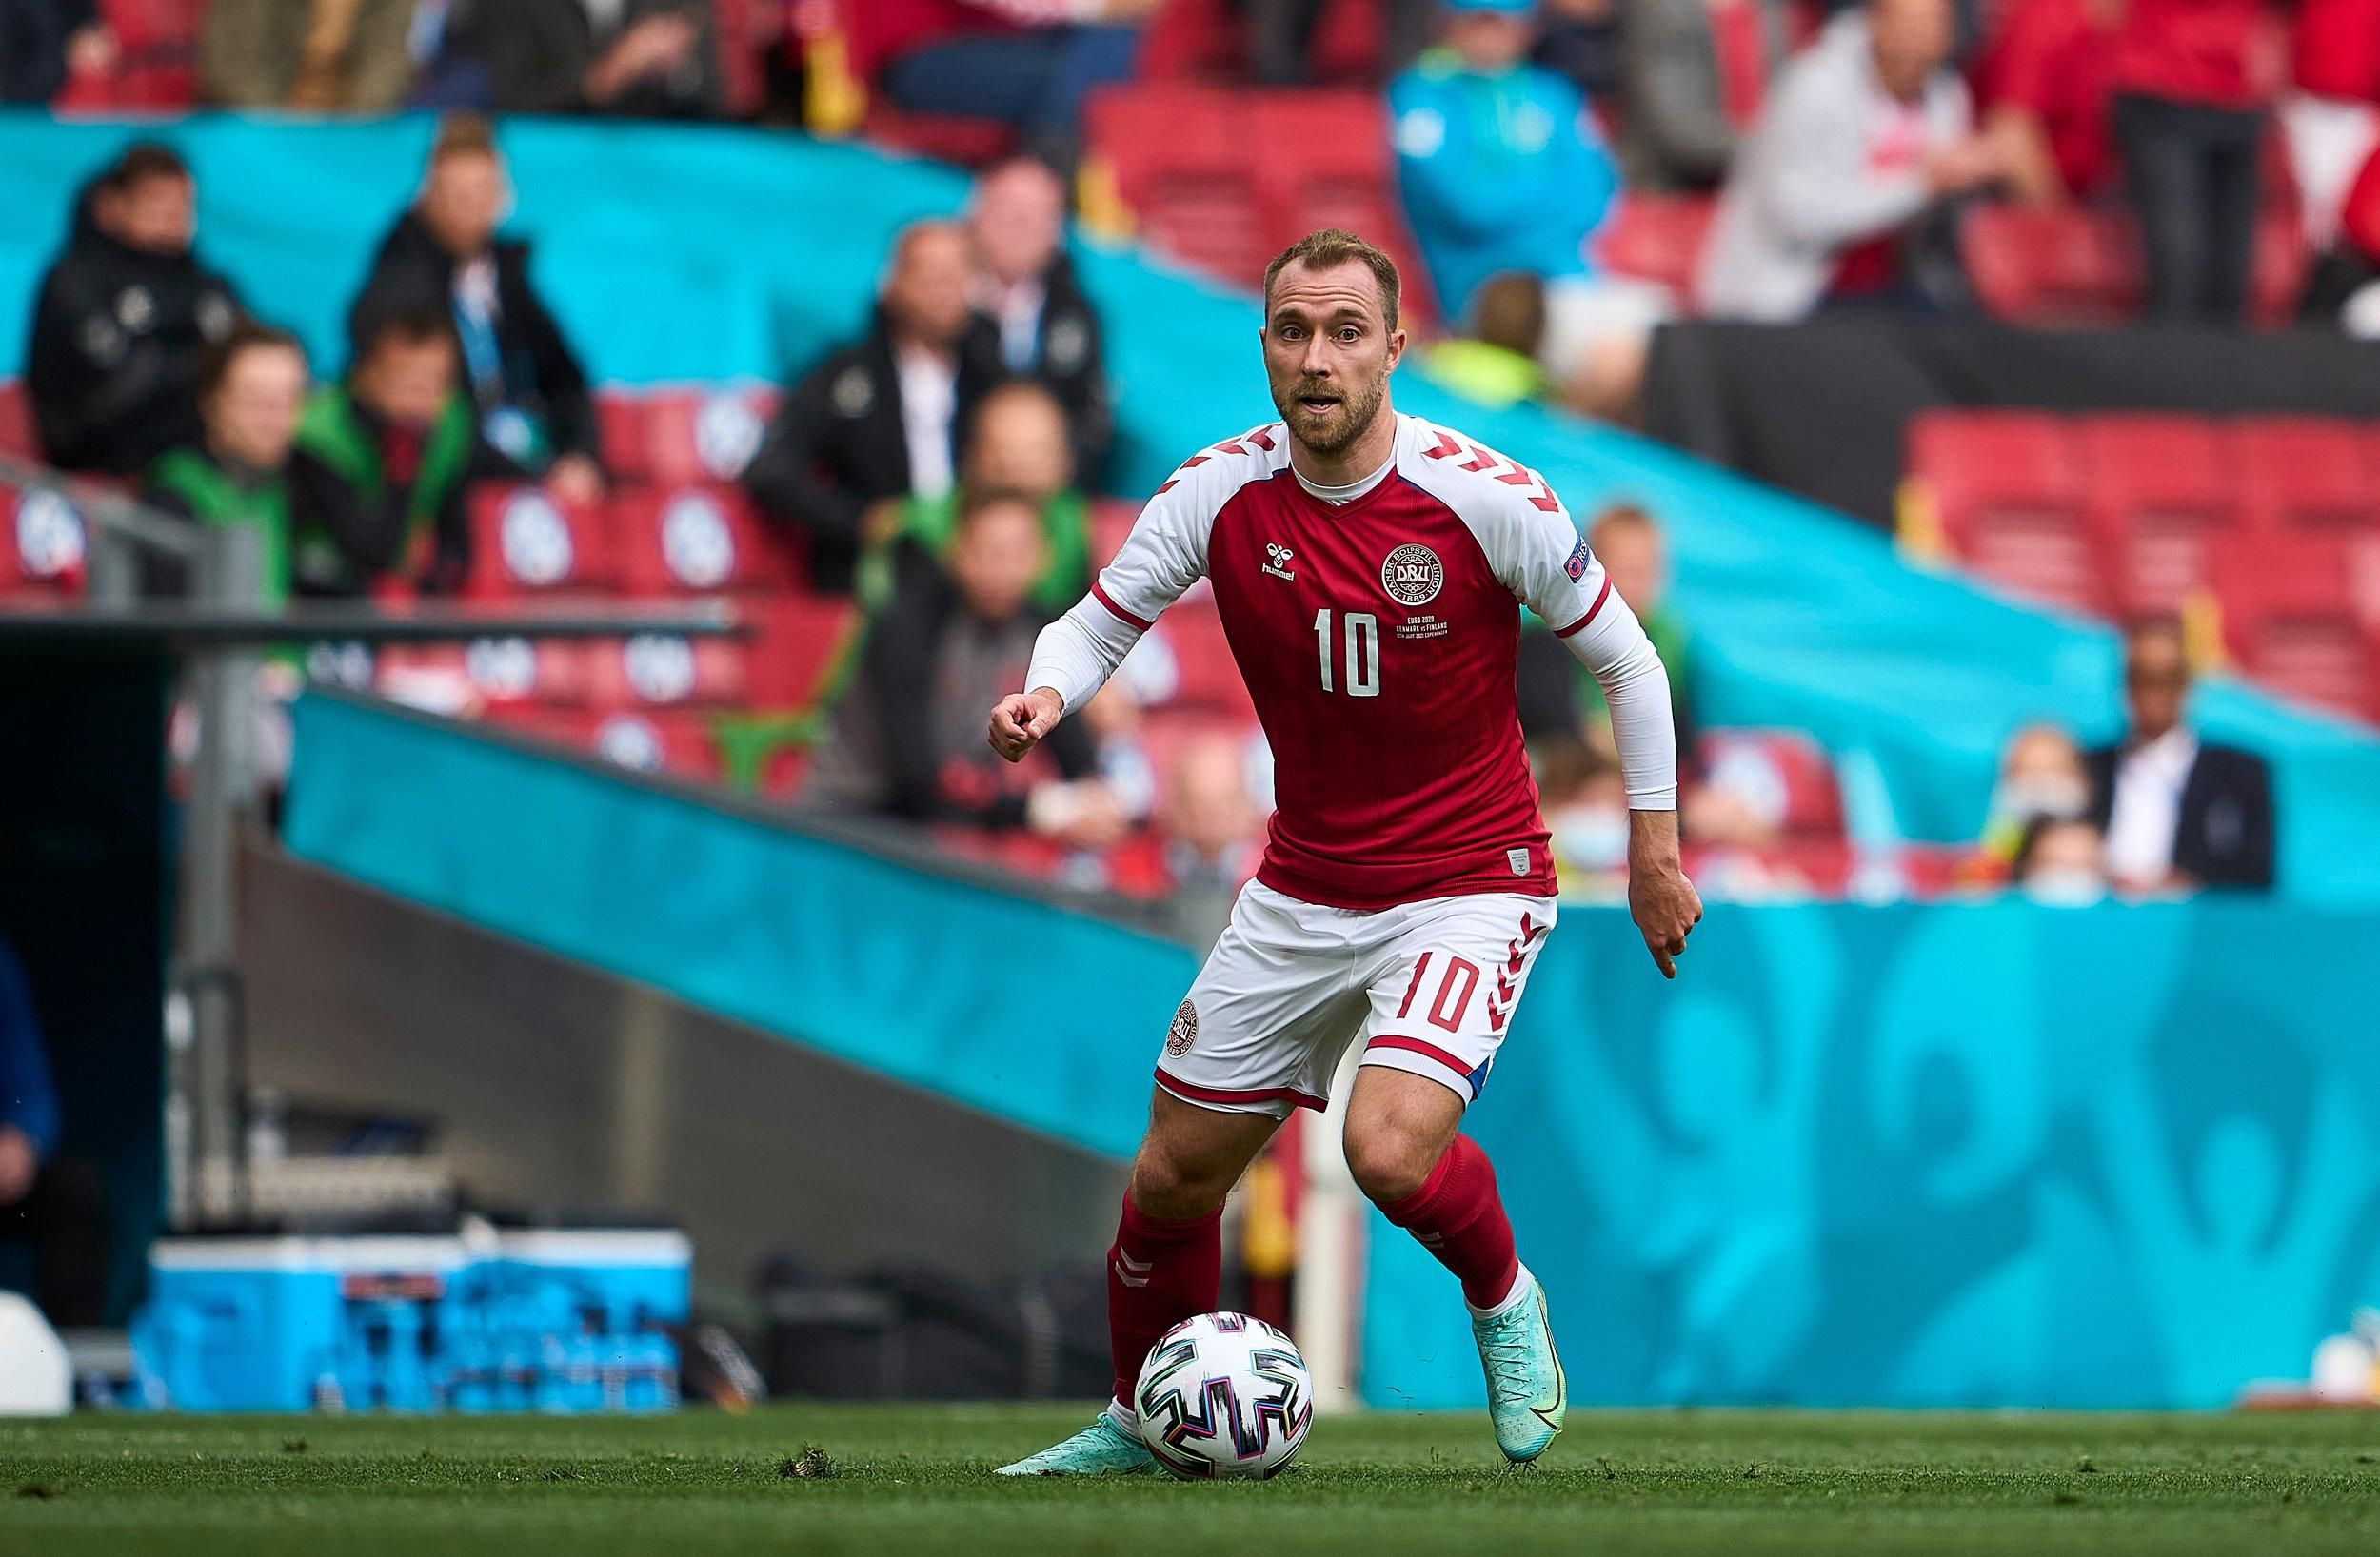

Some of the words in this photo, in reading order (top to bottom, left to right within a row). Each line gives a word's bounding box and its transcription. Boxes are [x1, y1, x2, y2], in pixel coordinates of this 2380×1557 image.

[1261, 562, 1295, 581] hummel
[1385, 562, 1400, 596] DANSK
[1427, 563, 1440, 595] UNION
[1396, 564, 1430, 582] DBU
[1401, 593, 1426, 602] 1889
[1421, 615, 1435, 624] 2020
[1426, 621, 1447, 632] FINLAND
[1314, 608, 1379, 697] 10
[1397, 951, 1479, 1034] 10
